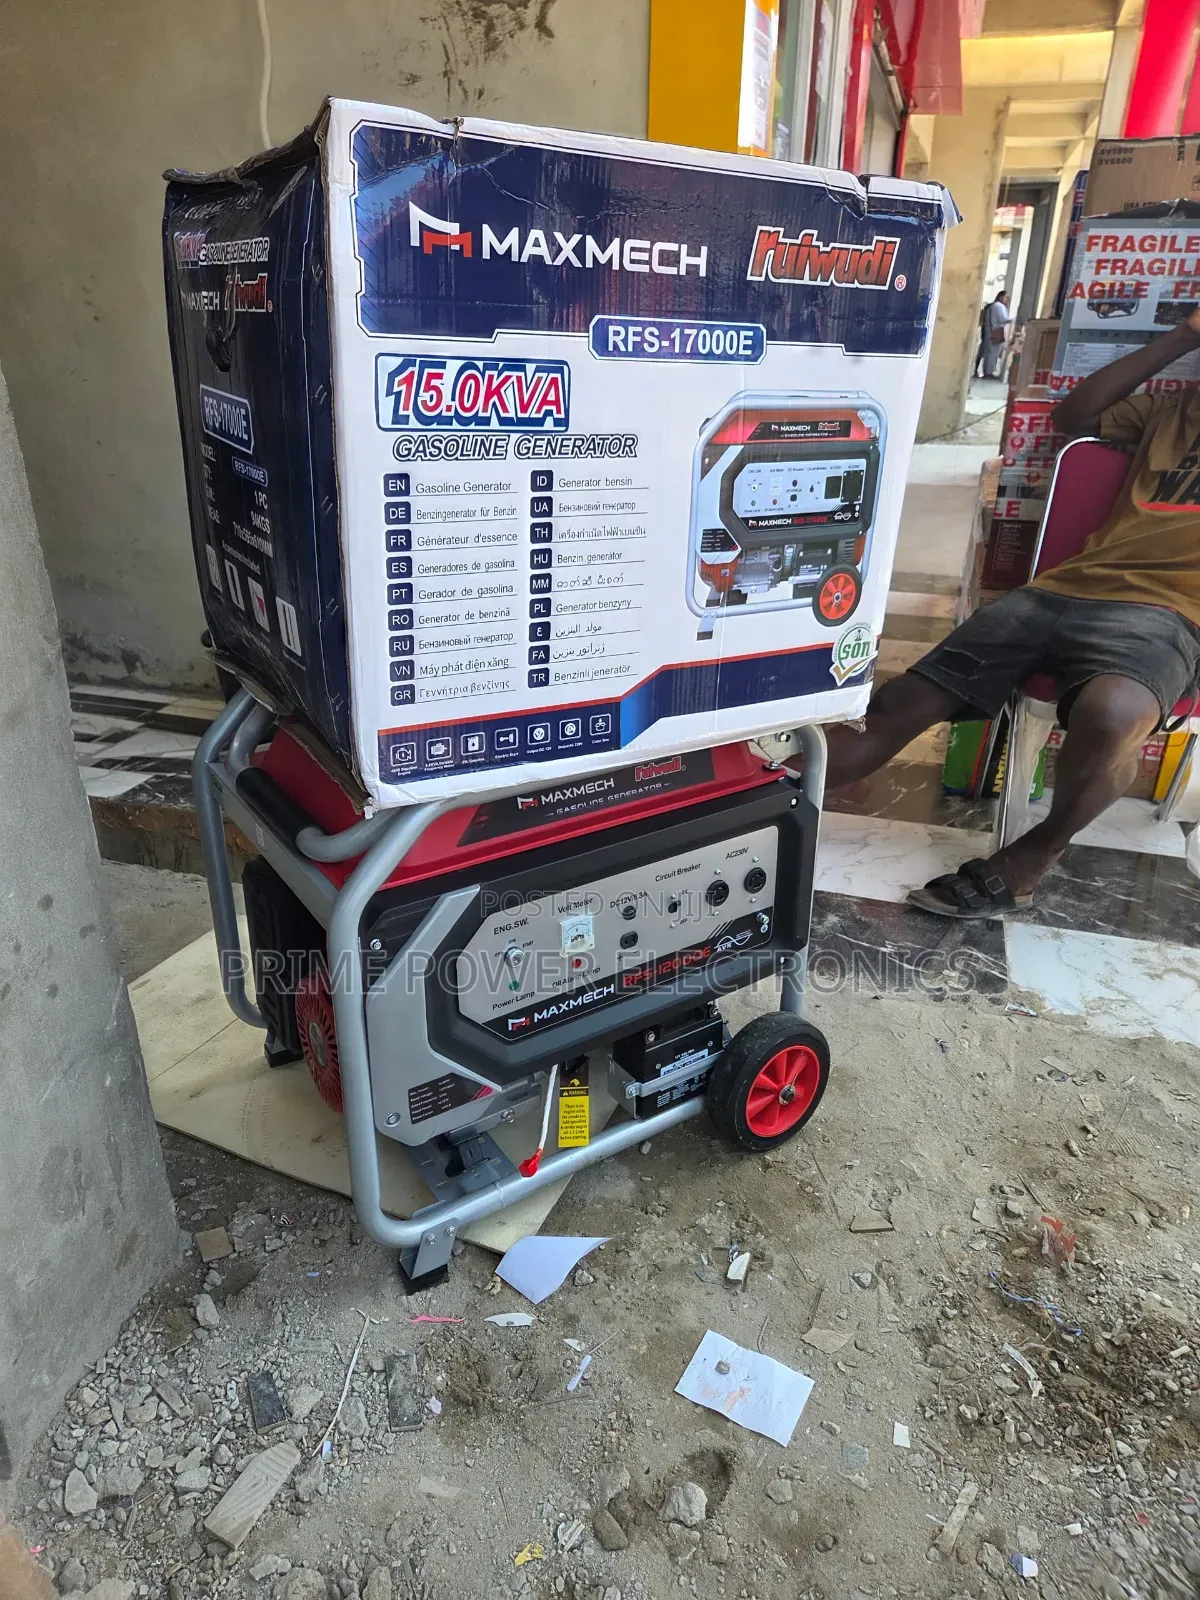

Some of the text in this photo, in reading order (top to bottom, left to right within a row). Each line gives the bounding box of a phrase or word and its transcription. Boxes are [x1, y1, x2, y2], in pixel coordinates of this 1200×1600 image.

[1085, 235, 1200, 253] FRAGILE
[482, 223, 902, 290] MAXMECH ruiwudi
[607, 325, 754, 357] RFS-17000E
[386, 362, 568, 427] 15.0KVA
[203, 396, 249, 441] RFS-17000E
[392, 434, 638, 462] GASOLINE GENERATOR
[234, 460, 265, 483] RFS-17000E
[388, 479, 512, 494] EN Gasoline Generator
[536, 475, 633, 489] ID Generator bensin
[389, 506, 517, 521] DE Benzingenerator für Benzin
[534, 502, 549, 513] UA
[559, 500, 636, 513] Бензиновий генератор
[390, 532, 518, 547] FR Générateur d'essence
[534, 527, 549, 538] TH
[533, 550, 623, 565] HU Benzin generátor
[391, 558, 515, 575] ES Generadores de gasolina
[392, 584, 514, 600] PT Gerador de gasolina
[532, 578, 549, 590] MM
[534, 598, 632, 614] PL Generator benzyny
[392, 608, 511, 626] RO Generator de benzină
[393, 640, 410, 652] RU
[418, 631, 514, 651] Бензиновый генератор
[532, 650, 546, 661] FA
[394, 656, 510, 678] VN Máy phát điện xăng
[532, 664, 631, 683] TR Benzinli jeneratör
[394, 690, 411, 701] GR
[541, 777, 614, 806] MAXMECH
[655, 862, 702, 882] Circuit Breaker
[558, 897, 594, 914] Volt Meter
[493, 918, 529, 935] ENG.SW.
[492, 991, 535, 1011] Power Lamp
[534, 984, 615, 1023] MAXMECH
